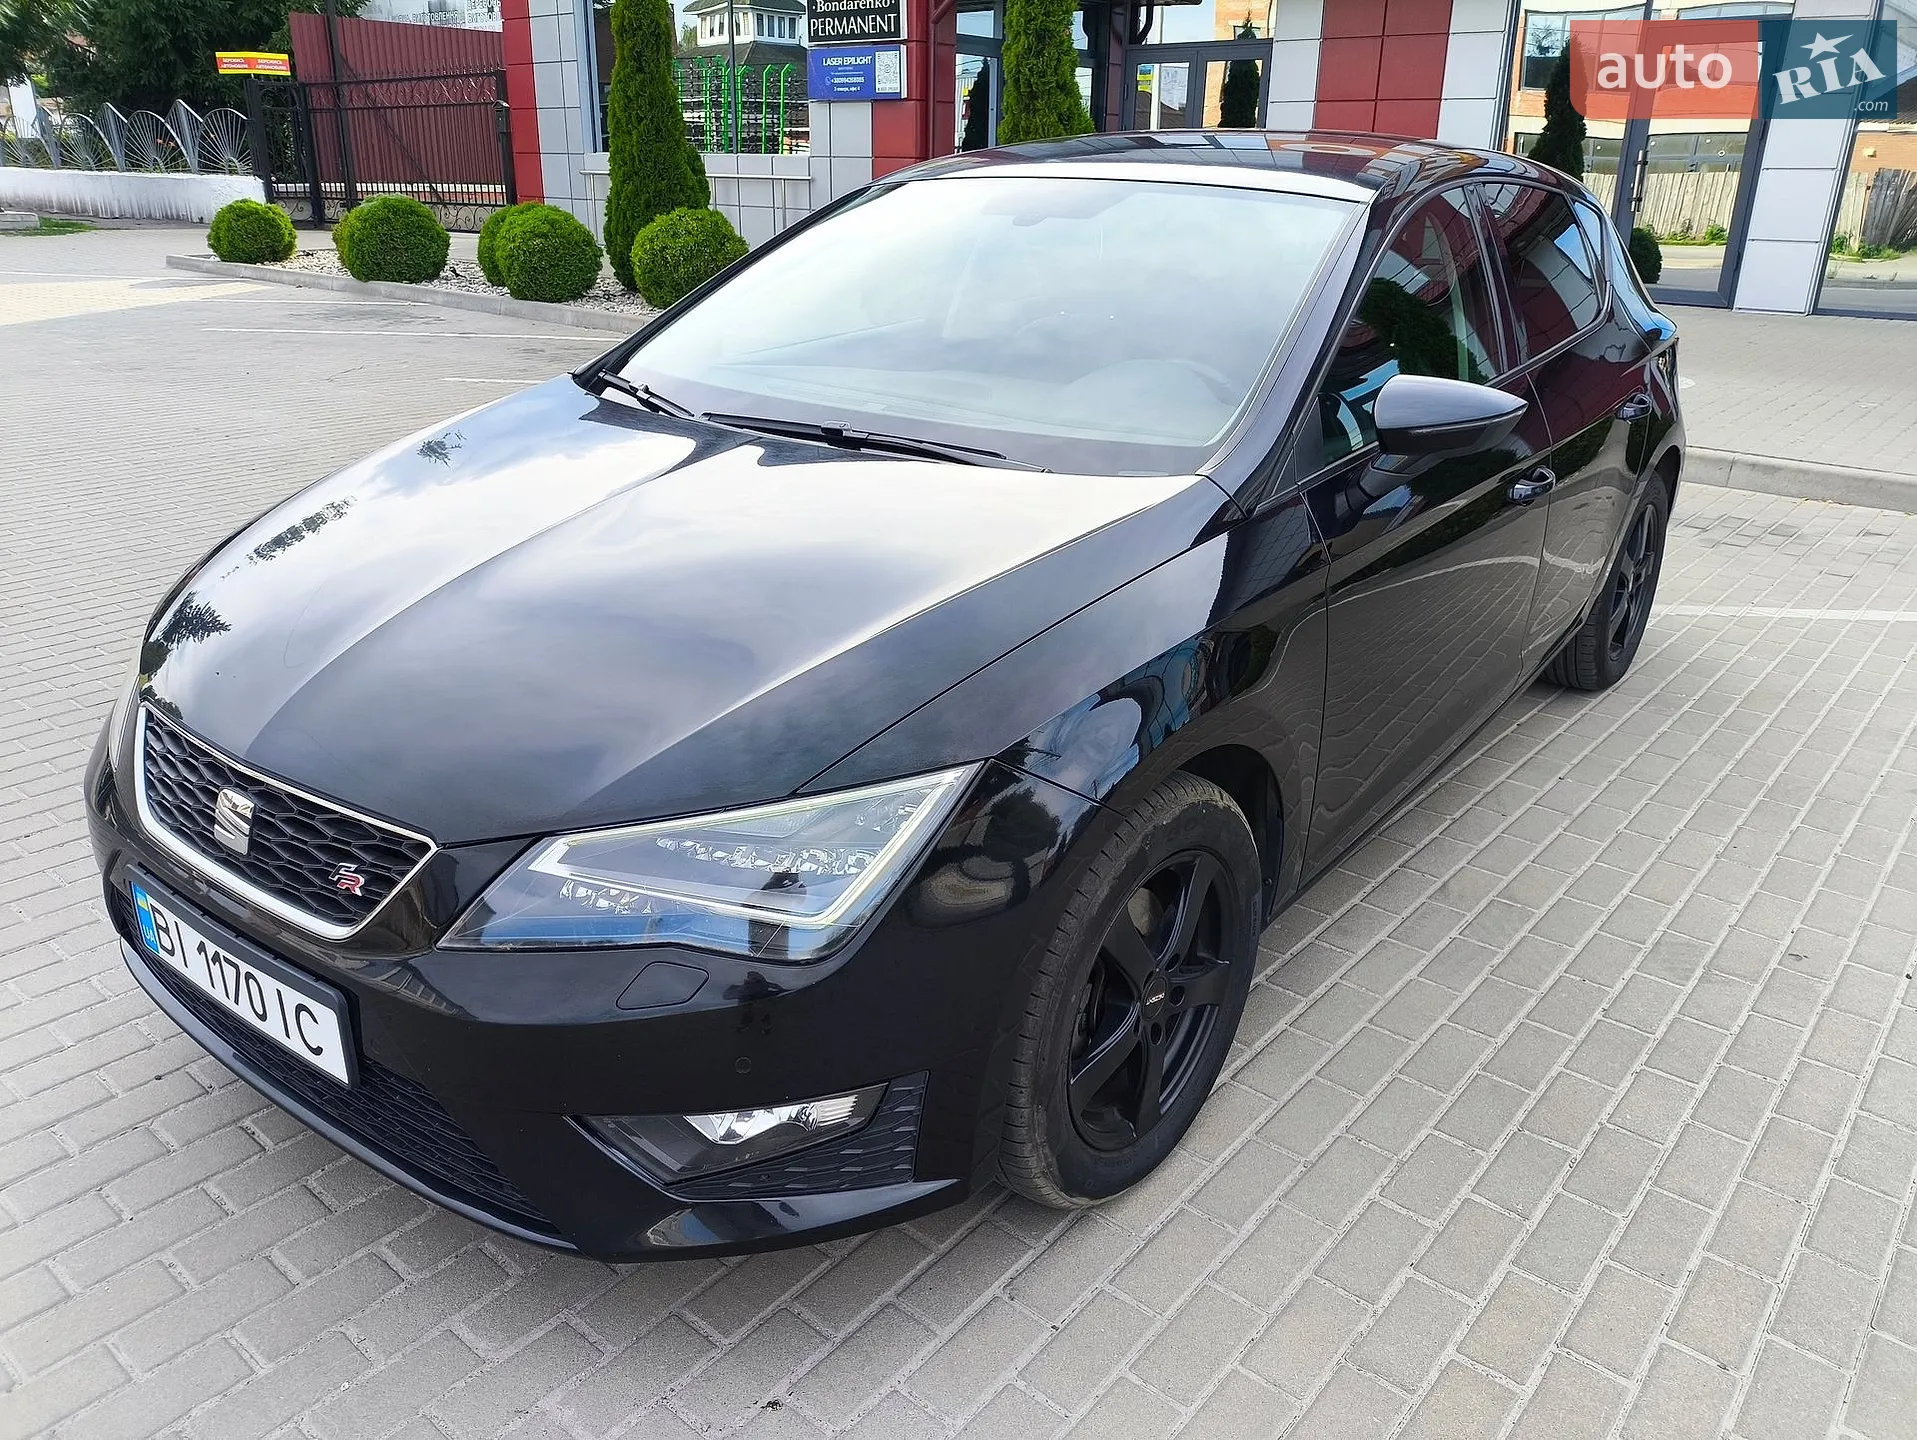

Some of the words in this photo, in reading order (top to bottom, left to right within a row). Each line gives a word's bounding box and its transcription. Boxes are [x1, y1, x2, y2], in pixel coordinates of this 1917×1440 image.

[810, 14, 897, 36] PERMANENT
[823, 57, 843, 66] LASER
[843, 56, 872, 65] EPILIGHT
[143, 926, 157, 943] UA
[197, 940, 268, 1023] 1170
[276, 987, 324, 1057] IC
